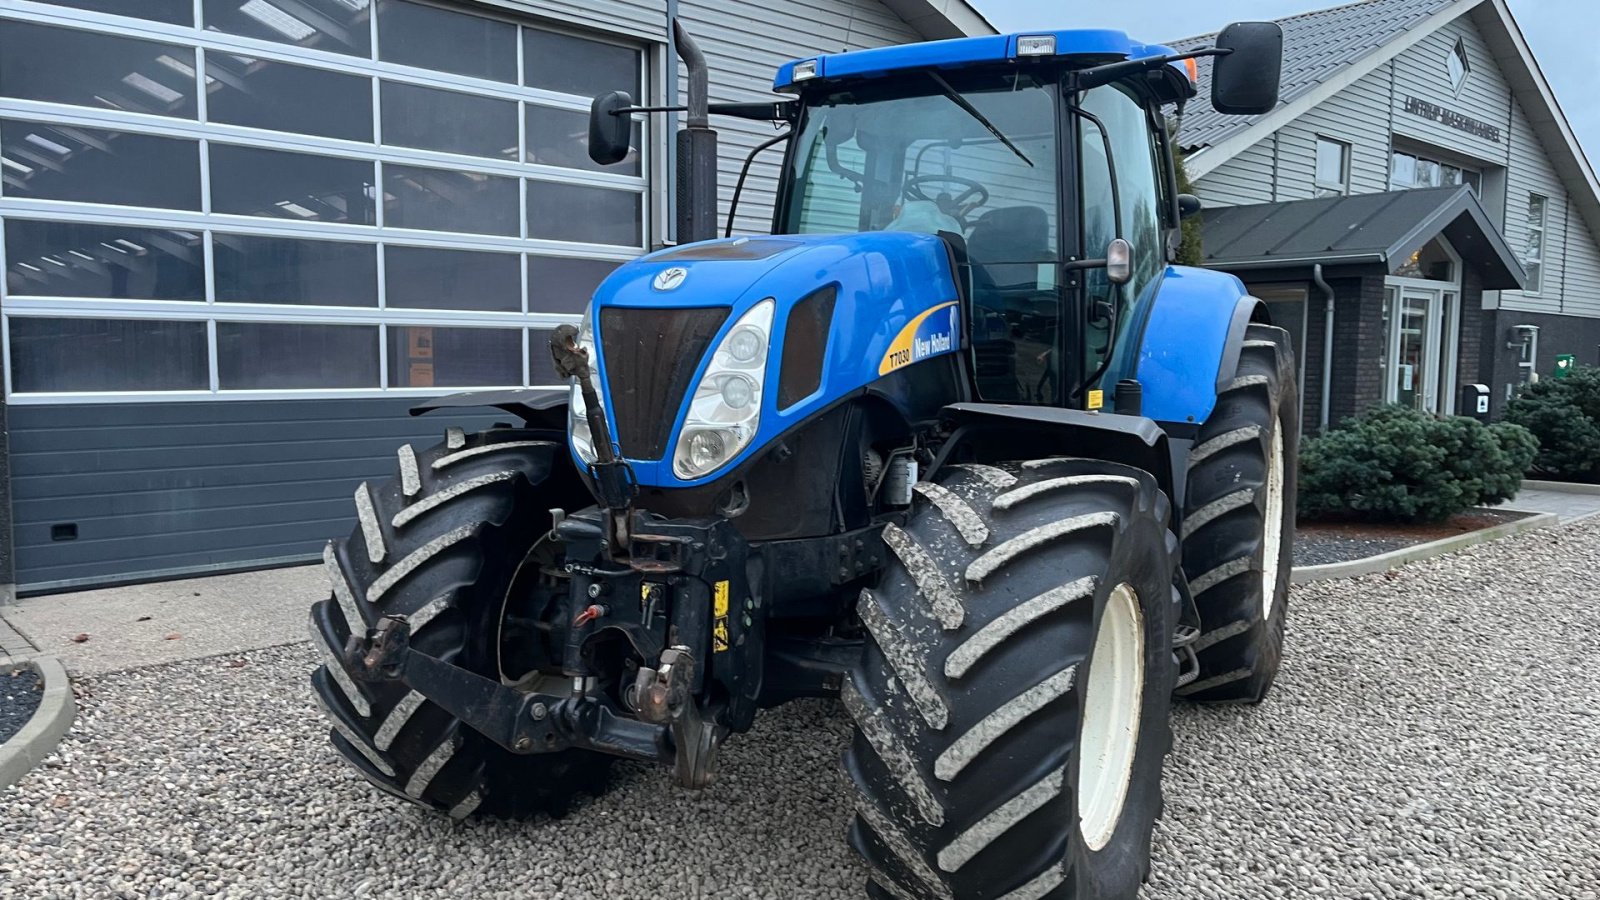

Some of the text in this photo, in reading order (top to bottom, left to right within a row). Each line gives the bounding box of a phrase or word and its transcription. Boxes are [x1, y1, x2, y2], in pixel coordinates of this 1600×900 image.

[914, 331, 950, 358] New Holland
[889, 348, 910, 368] T7030
